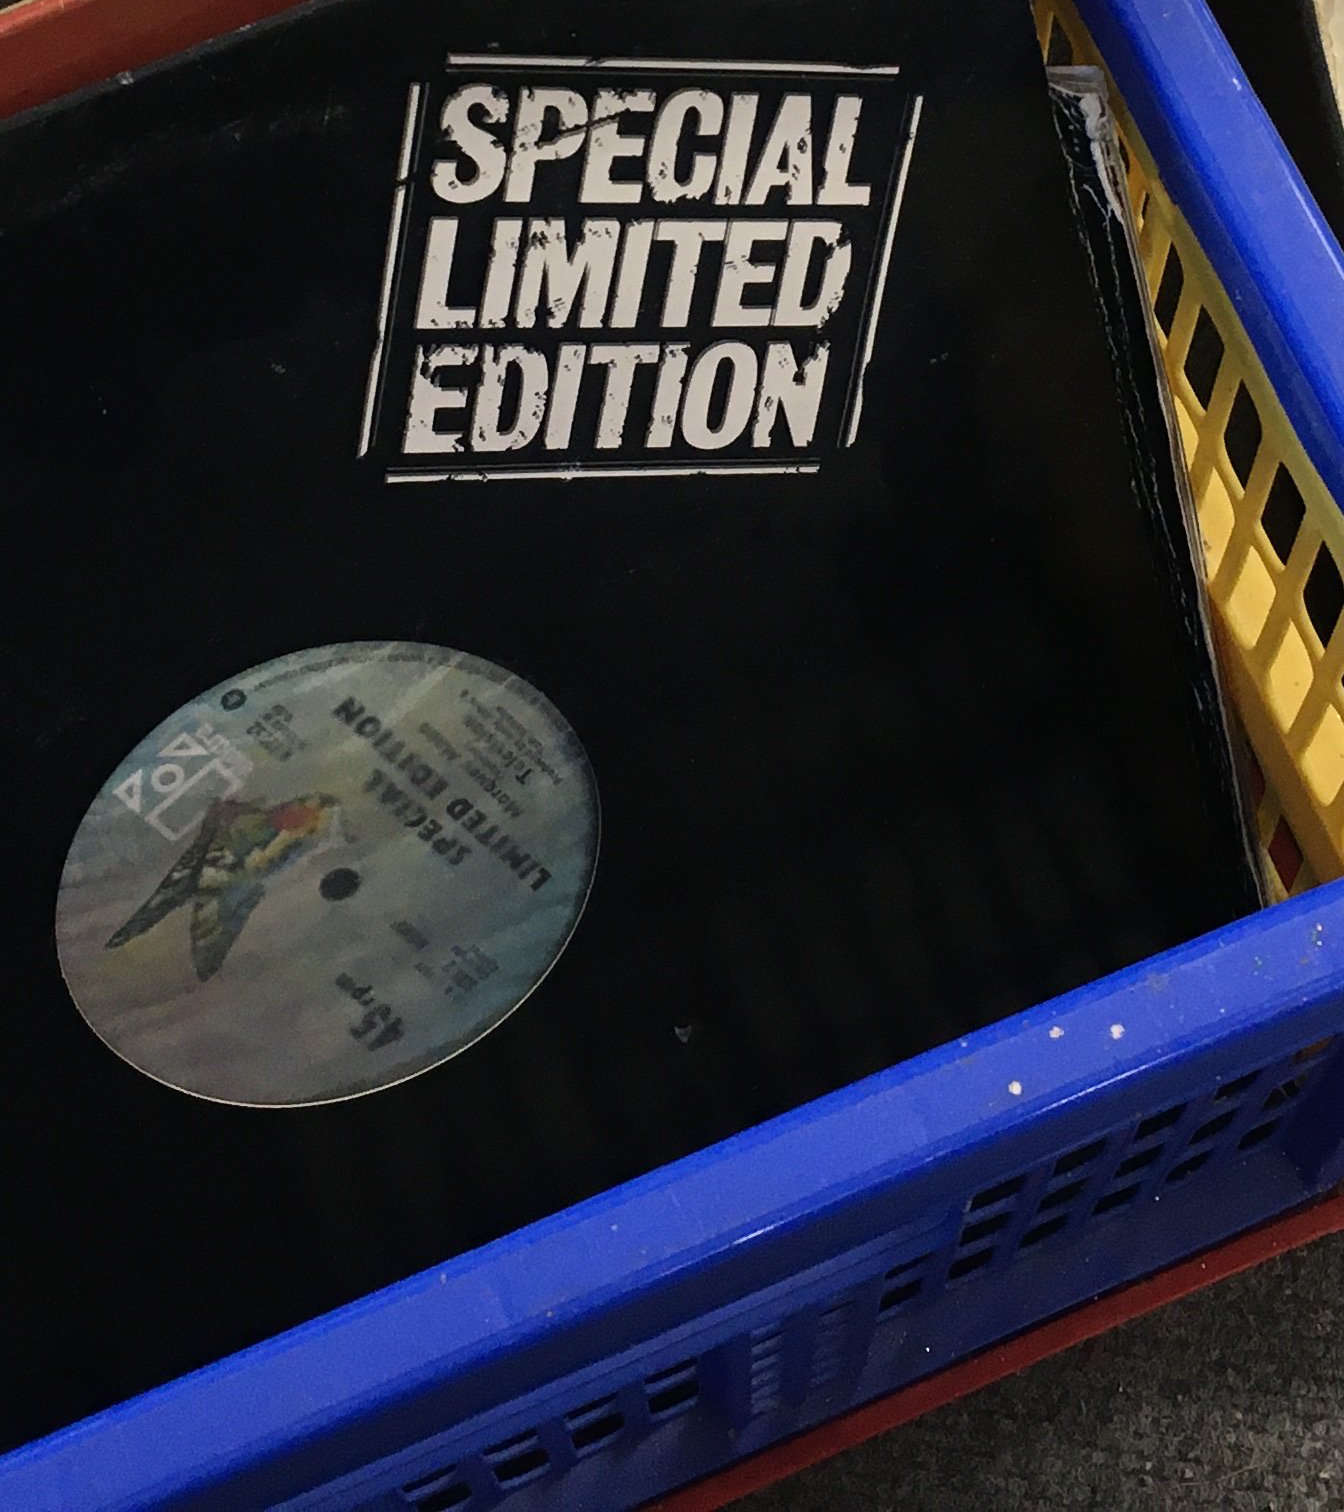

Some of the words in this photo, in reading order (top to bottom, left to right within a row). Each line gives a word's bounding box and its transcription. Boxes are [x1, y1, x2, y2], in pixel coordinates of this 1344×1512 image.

[430, 82, 870, 205] SPECIAL
[414, 217, 851, 329] LIMITED
[402, 340, 829, 453] EDITION
[332, 696, 450, 801] EDITION
[362, 768, 473, 867] SPECIAL
[446, 798, 553, 892] LIMITED
